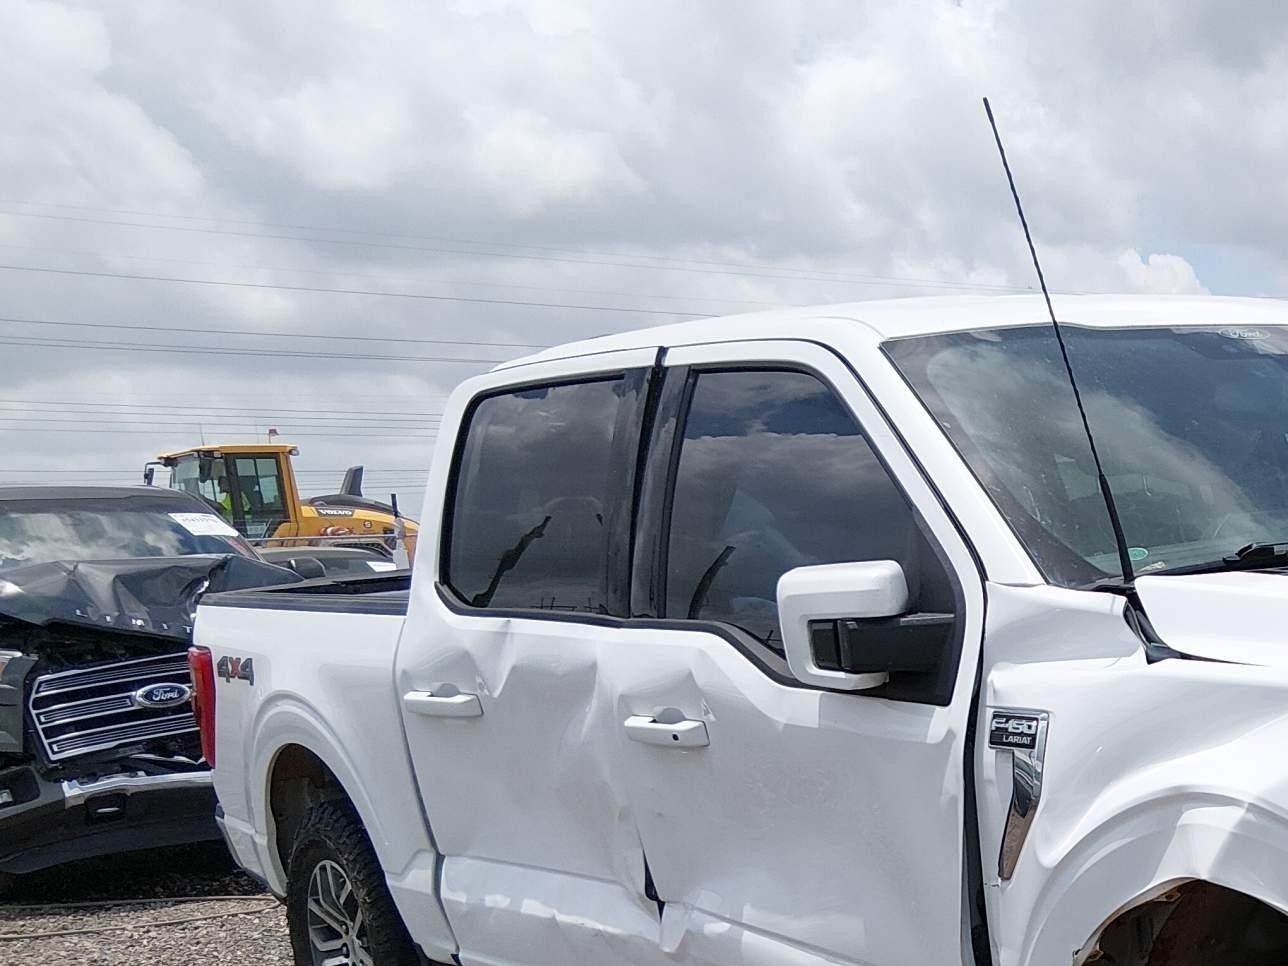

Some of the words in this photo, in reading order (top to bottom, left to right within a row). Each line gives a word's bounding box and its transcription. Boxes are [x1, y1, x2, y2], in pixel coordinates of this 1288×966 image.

[152, 687, 180, 701] Ford
[991, 717, 1038, 734] F-150
[1002, 734, 1033, 745] LARIAT
